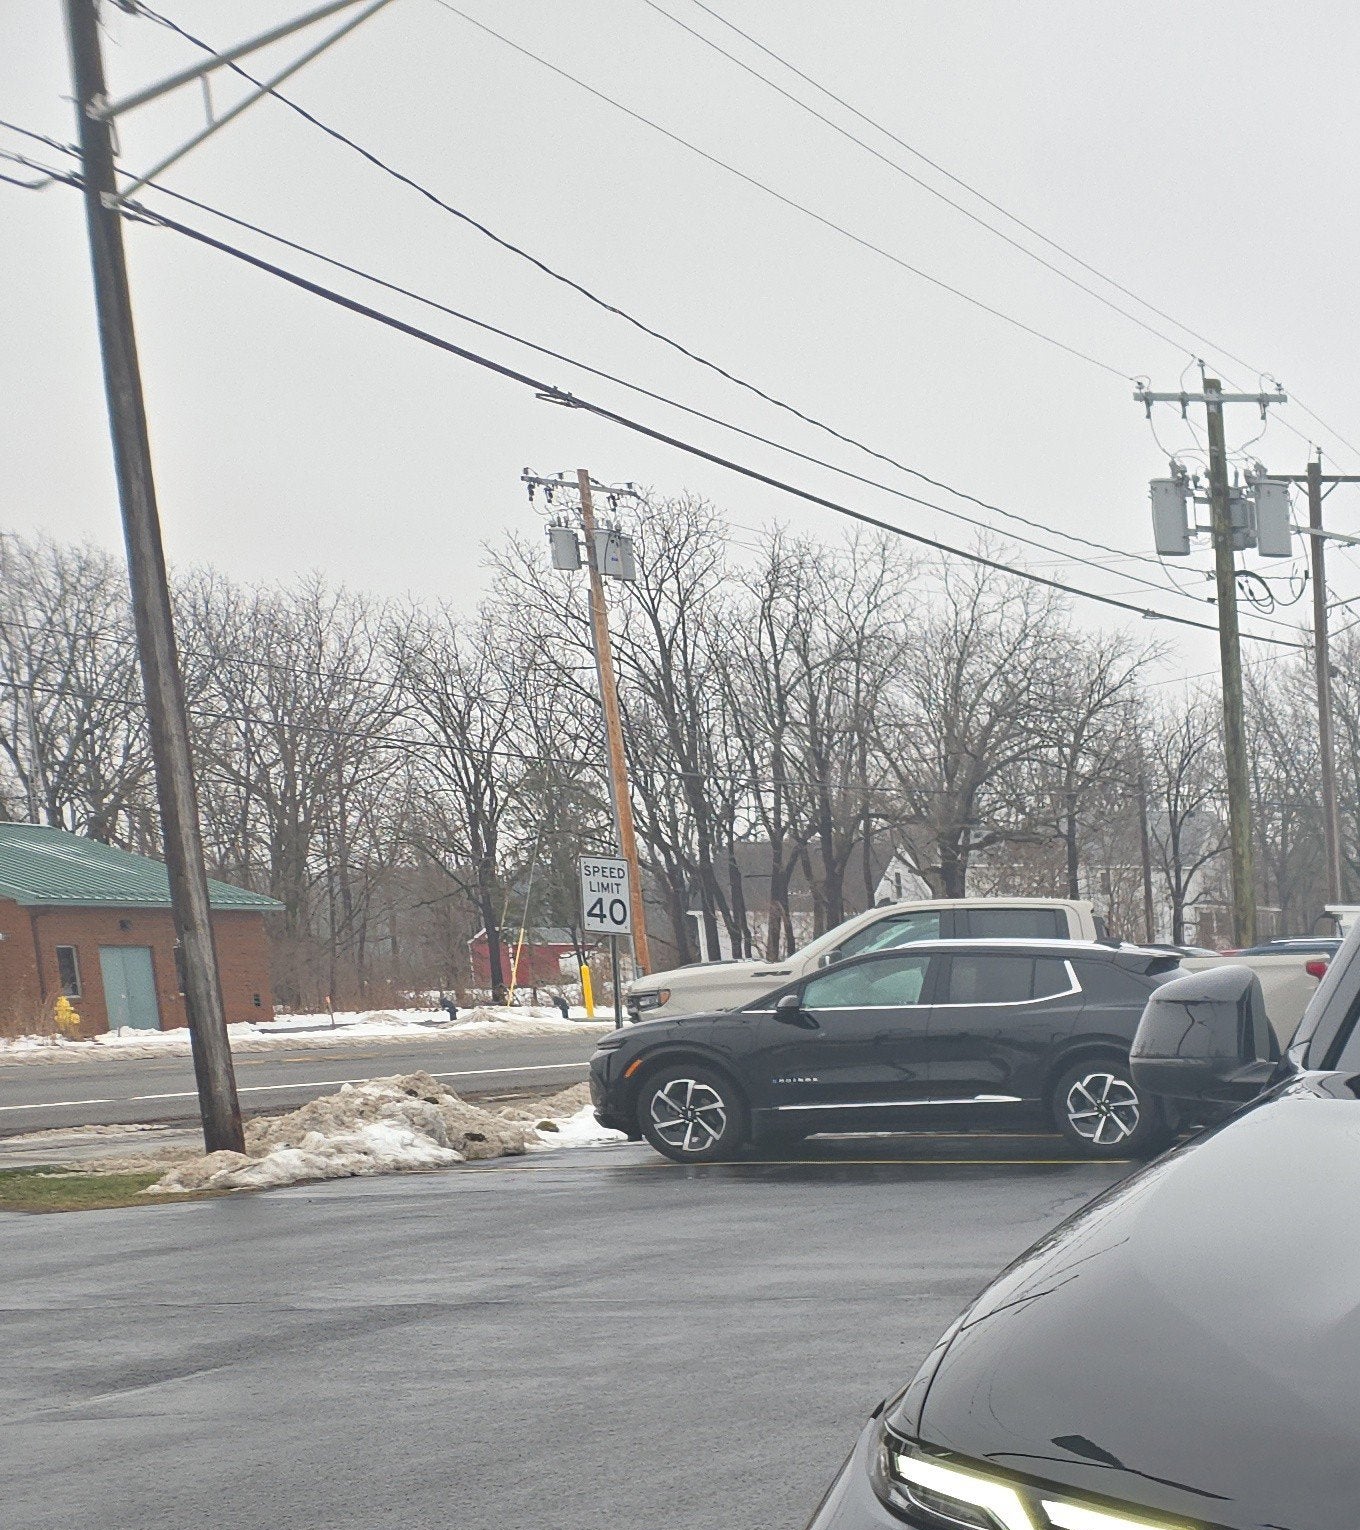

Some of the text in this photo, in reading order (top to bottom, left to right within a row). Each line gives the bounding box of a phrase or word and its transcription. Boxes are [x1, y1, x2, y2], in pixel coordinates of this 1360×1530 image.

[584, 865, 626, 879] SPEED
[589, 881, 622, 894] LIMIT
[587, 897, 627, 925] 40
